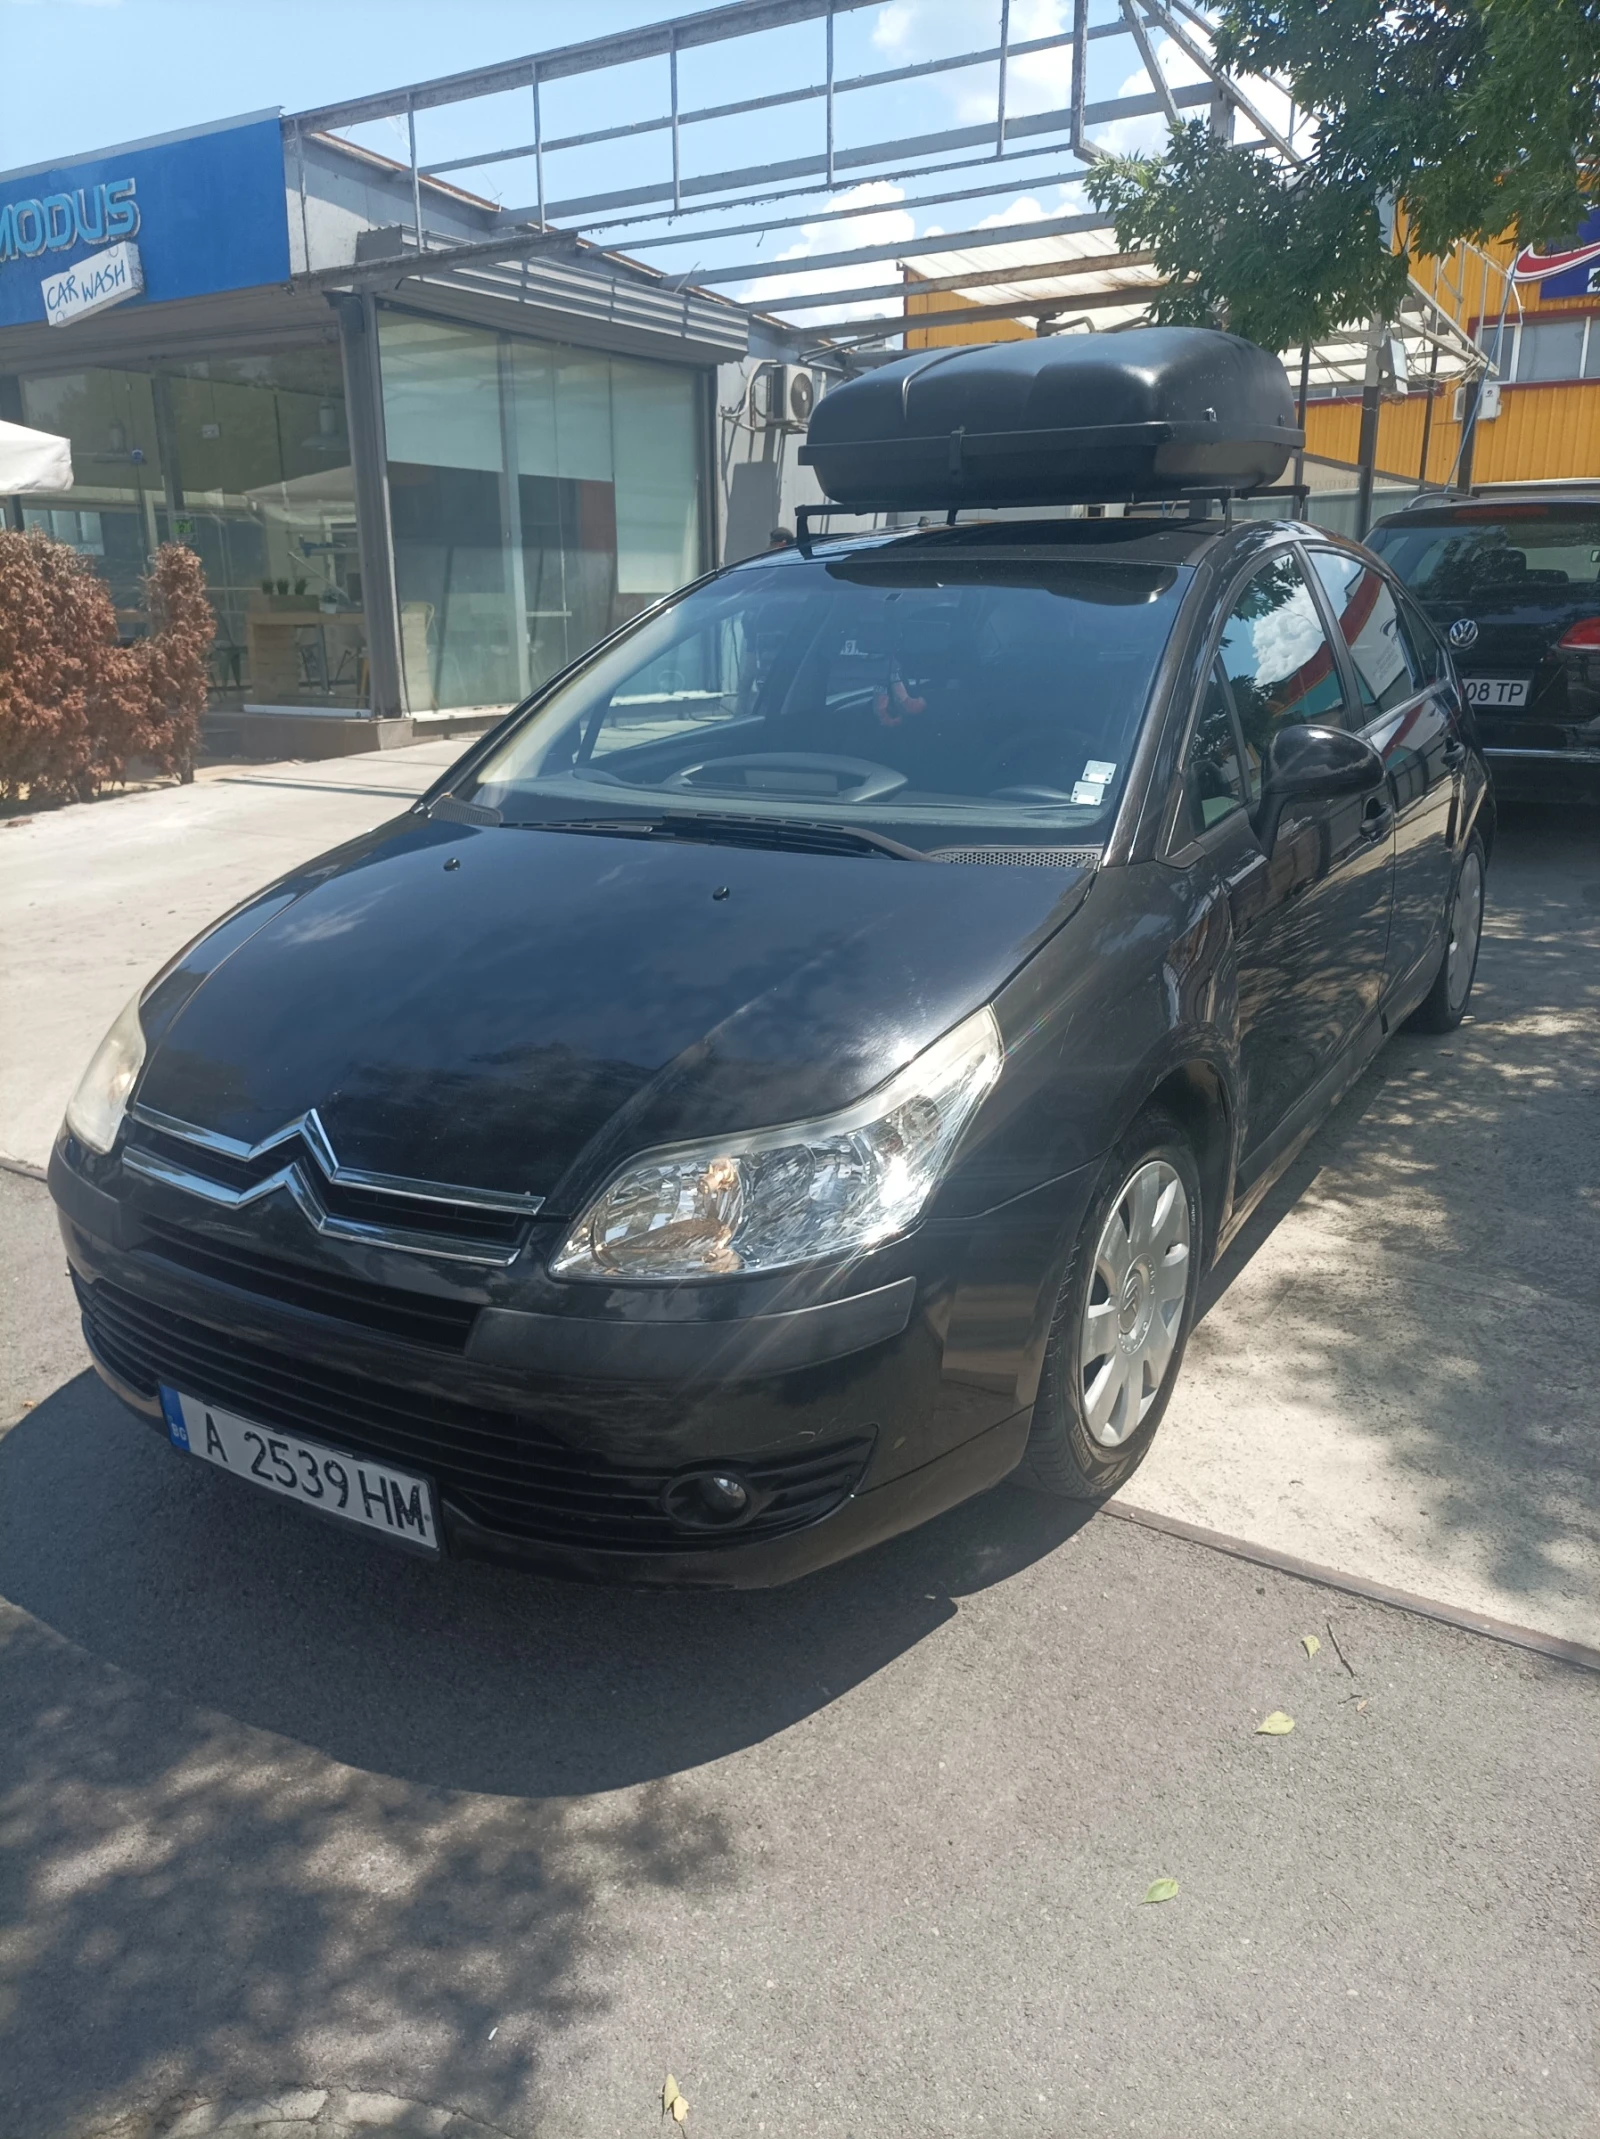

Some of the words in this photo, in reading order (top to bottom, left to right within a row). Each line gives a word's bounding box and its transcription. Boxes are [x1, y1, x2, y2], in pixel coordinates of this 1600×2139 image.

[47, 275, 79, 310] CAR
[82, 260, 125, 303] WASH
[1496, 683, 1523, 702] TP
[171, 1422, 187, 1441] BG
[205, 1412, 229, 1463] A
[243, 1430, 349, 1508] 2539
[357, 1469, 426, 1537] HM
